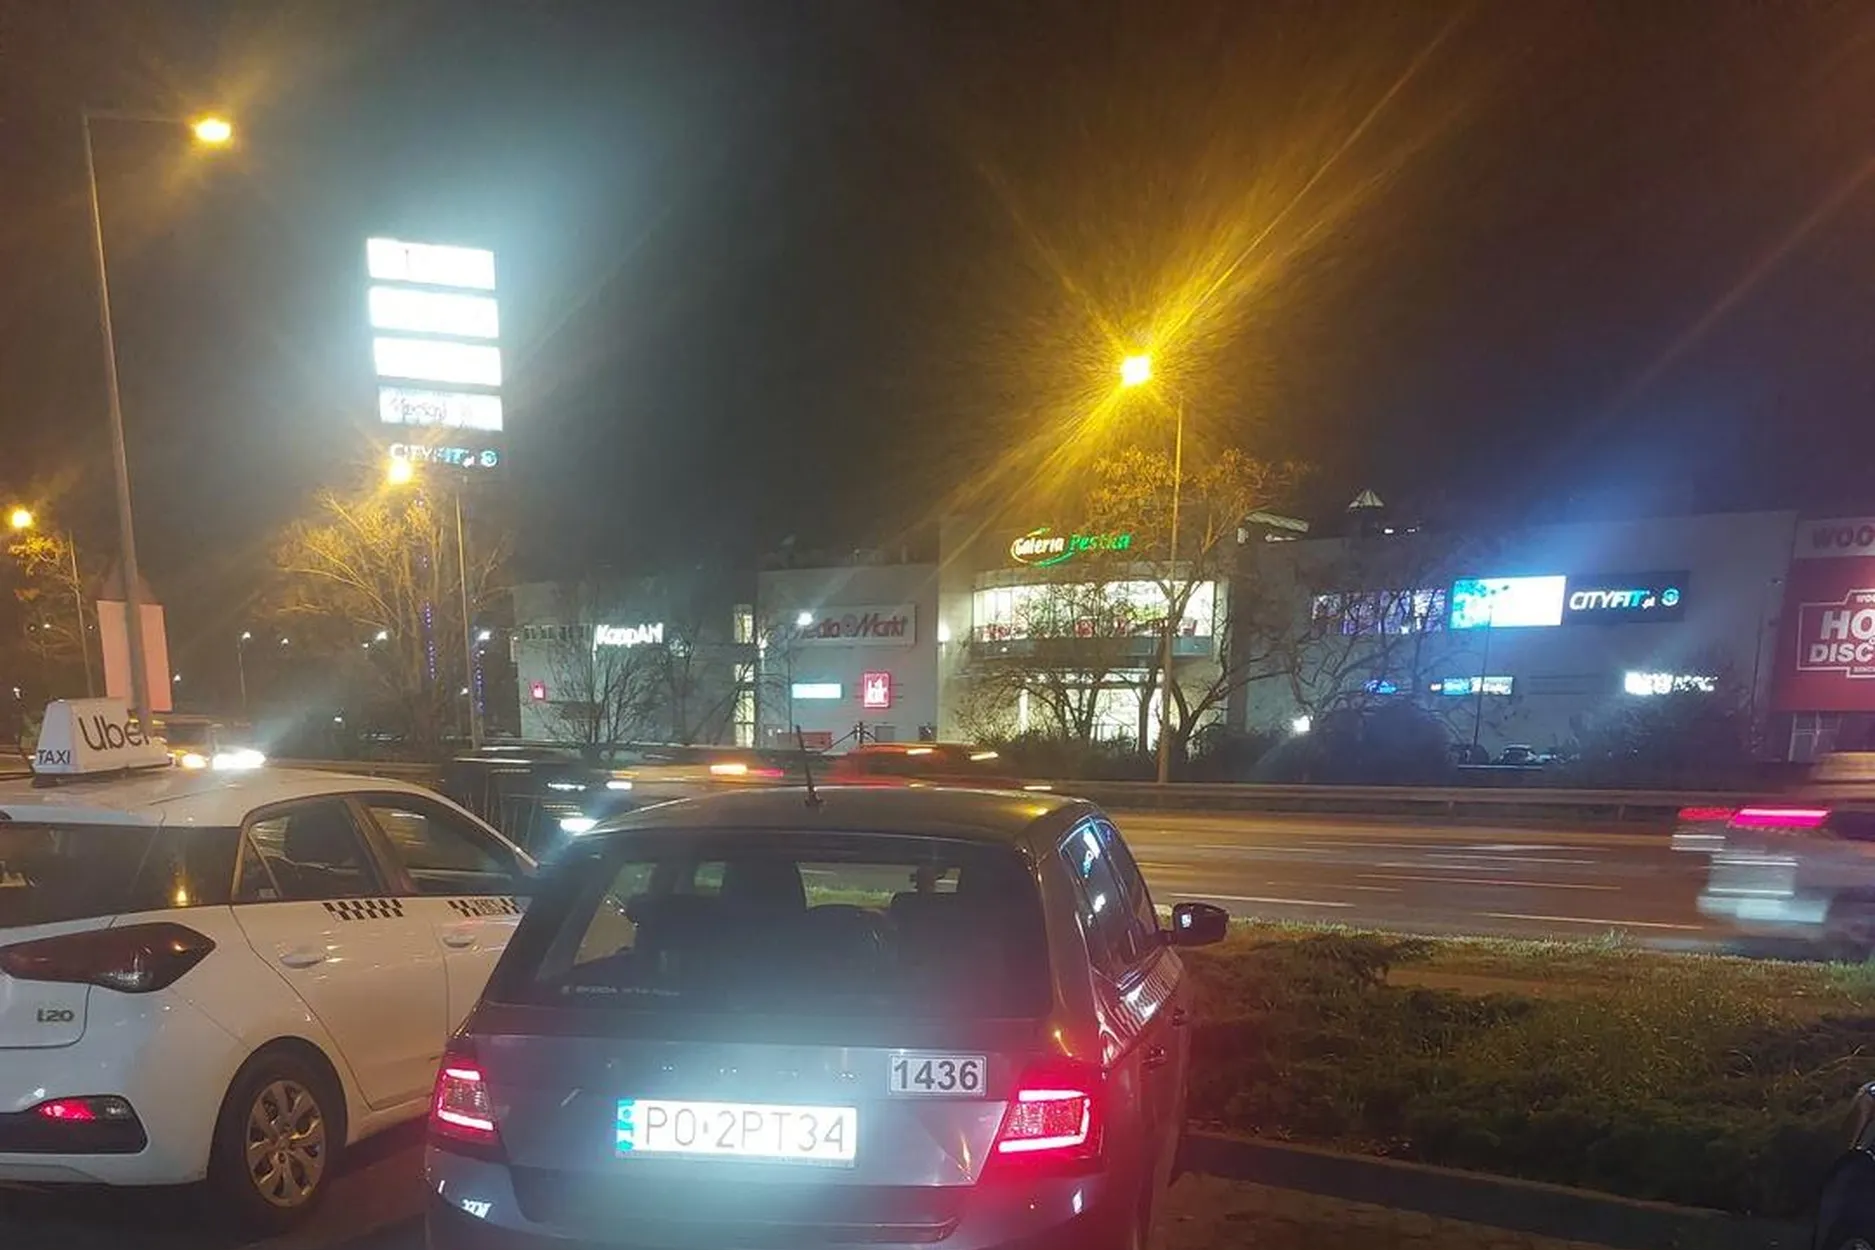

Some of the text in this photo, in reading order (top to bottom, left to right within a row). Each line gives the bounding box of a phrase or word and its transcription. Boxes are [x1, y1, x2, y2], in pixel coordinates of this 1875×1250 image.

[1820, 608, 1875, 640] HO
[1809, 642, 1873, 663] DISC
[38, 749, 71, 765] TAXI
[893, 1060, 979, 1091] 1436
[646, 1107, 844, 1153] PO 2PT34
